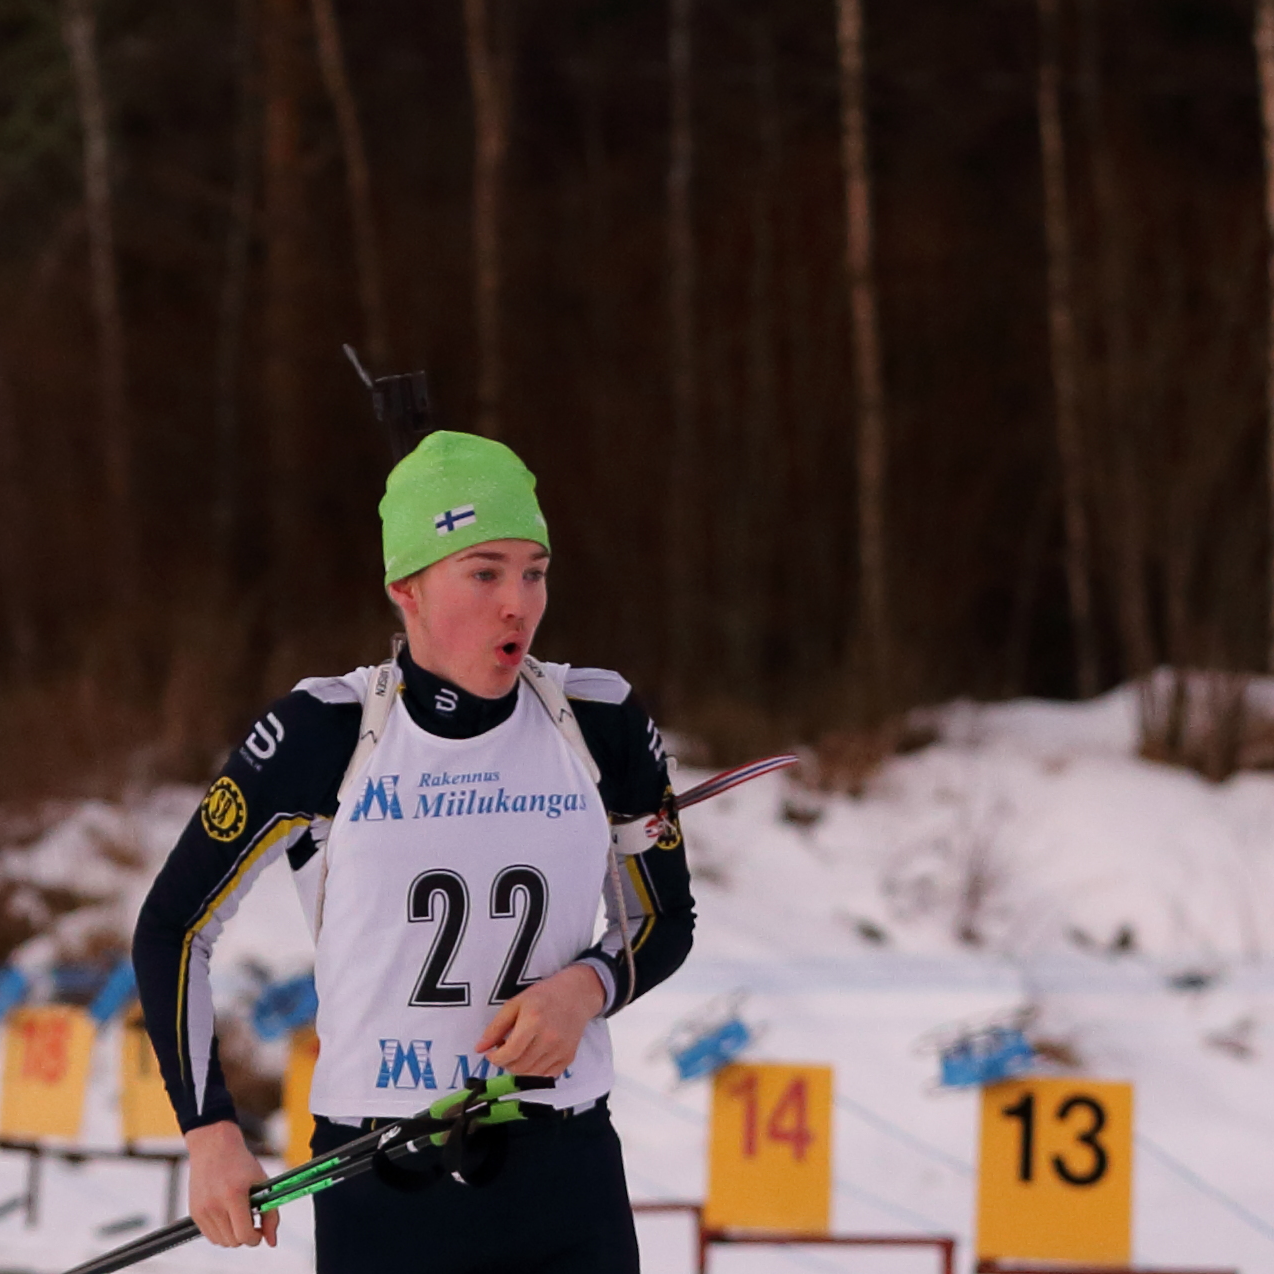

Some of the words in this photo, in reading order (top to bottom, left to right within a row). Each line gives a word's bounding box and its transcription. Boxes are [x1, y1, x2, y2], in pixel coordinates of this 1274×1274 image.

[412, 787, 587, 819] Miilukangas
[417, 770, 500, 788] Rakennus
[407, 864, 549, 1007] 22
[728, 1073, 814, 1163] 14
[1003, 1092, 1110, 1187] 13
